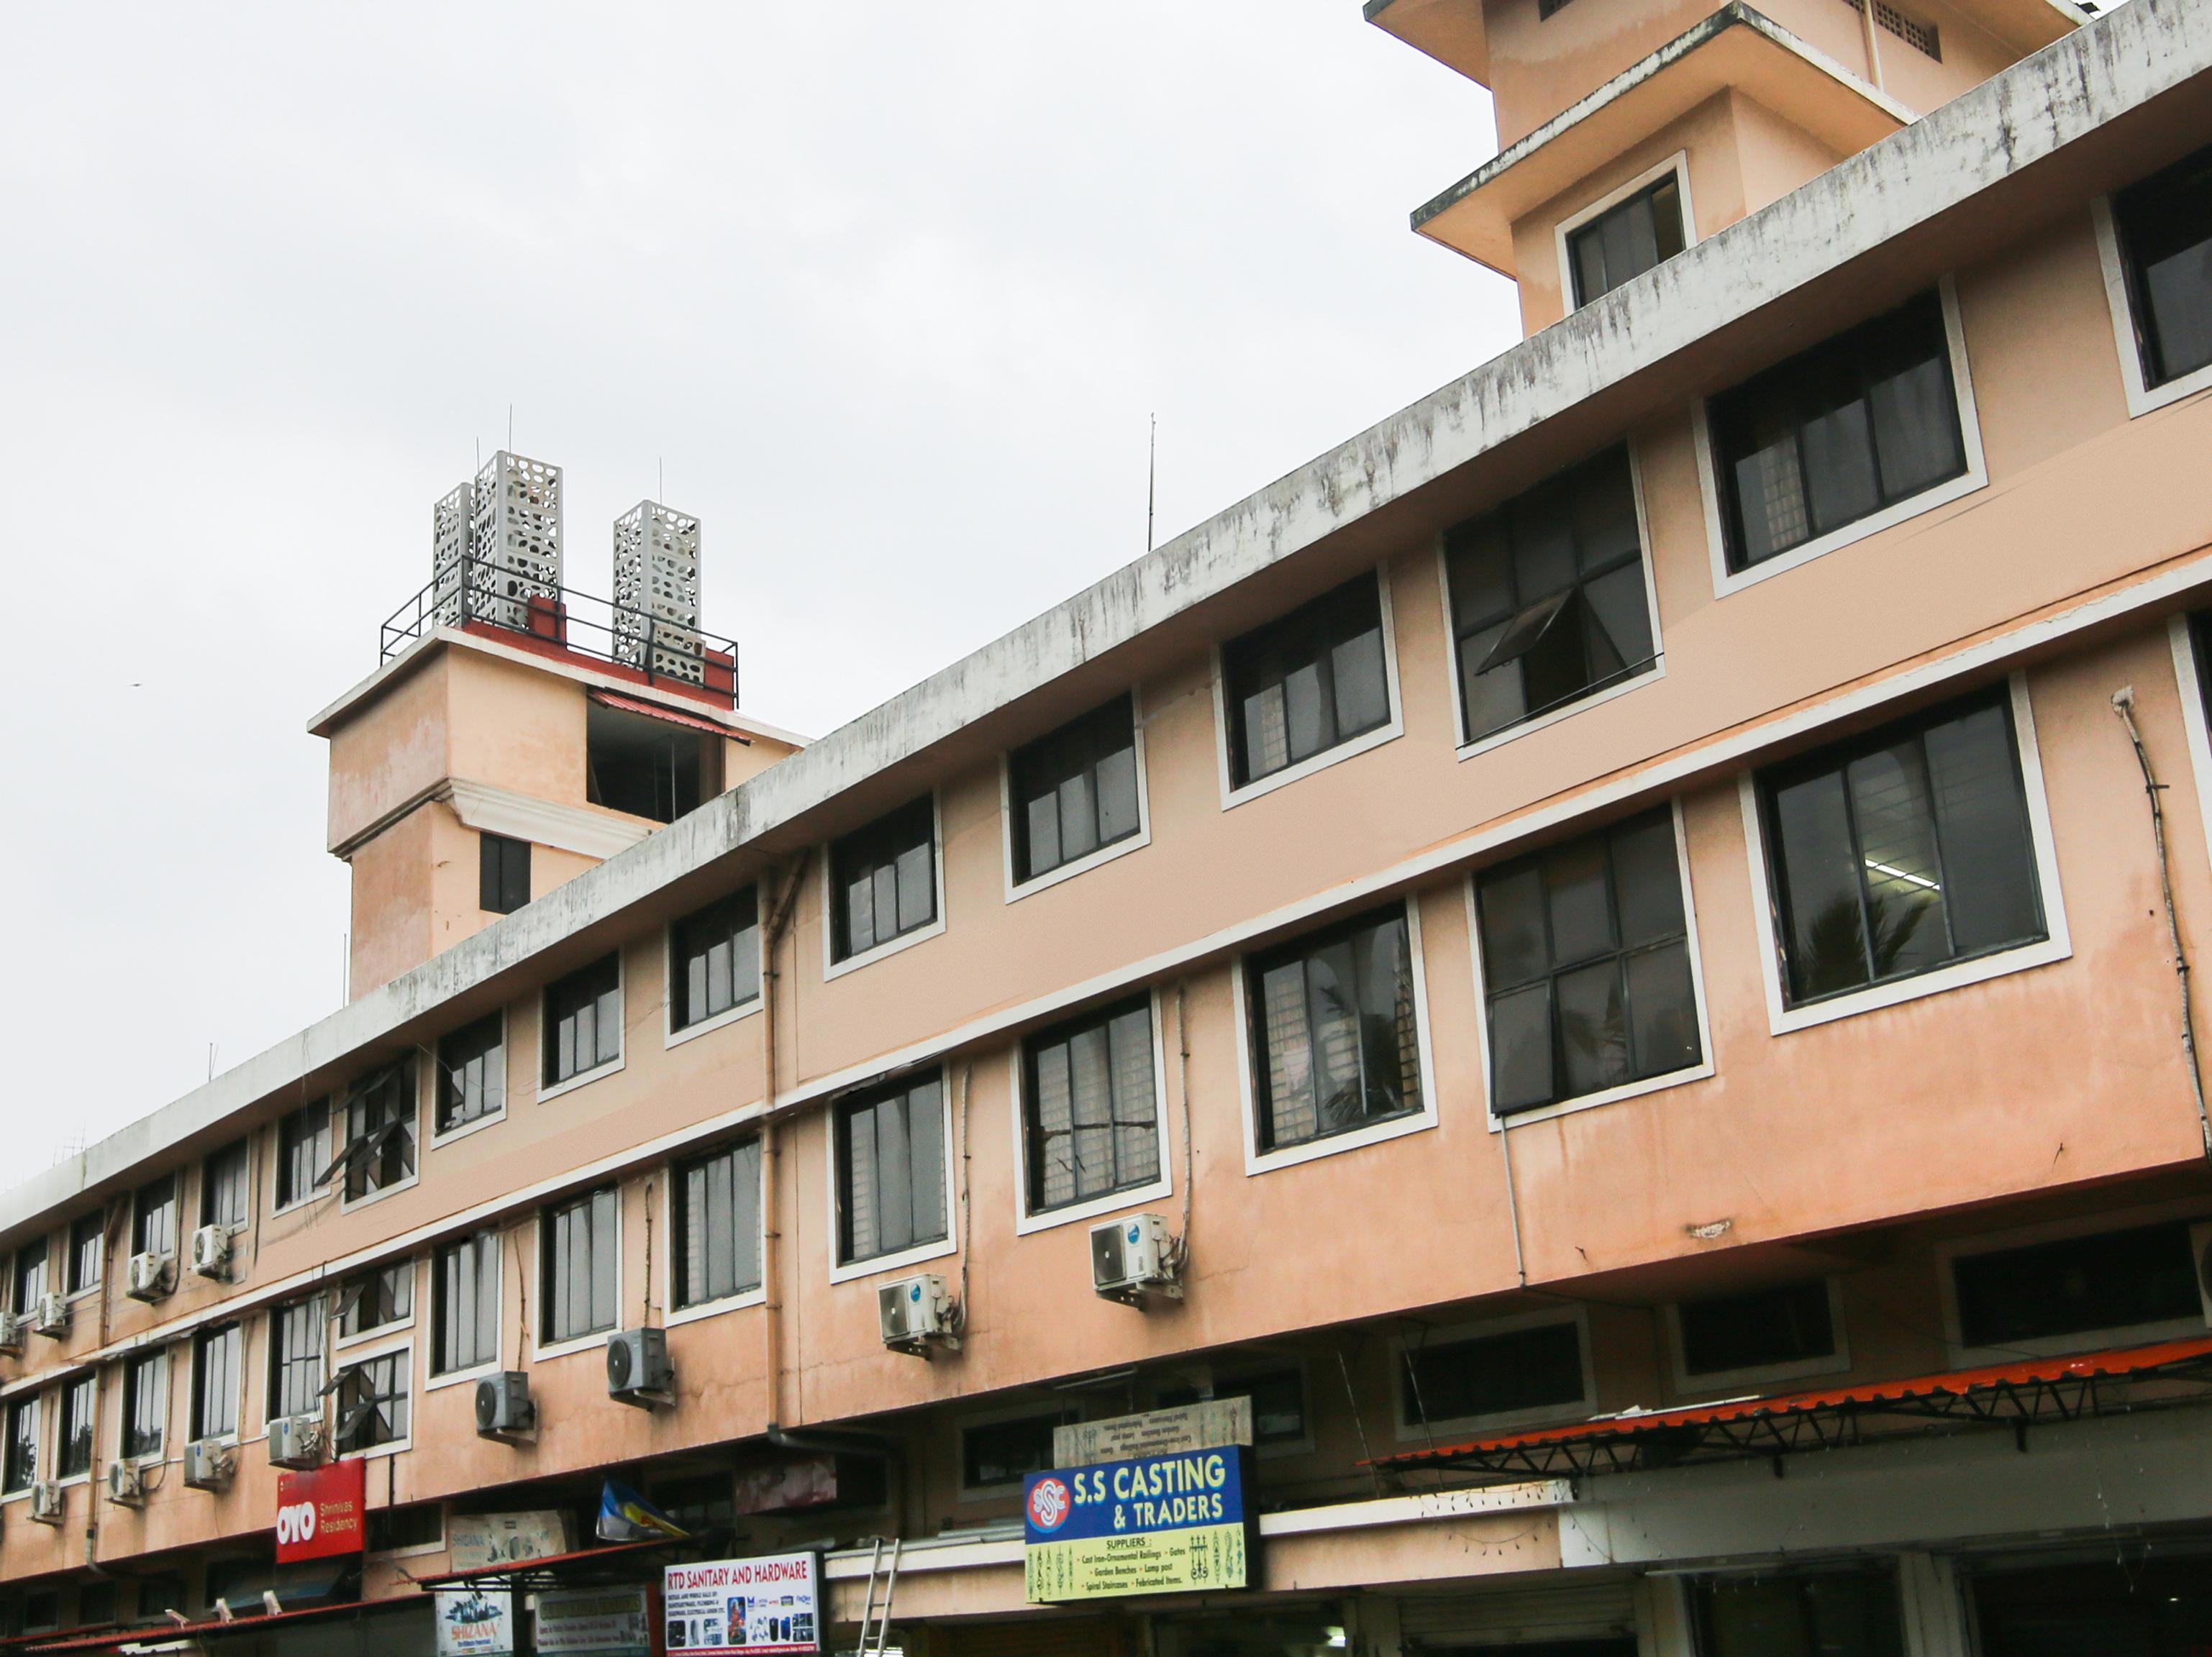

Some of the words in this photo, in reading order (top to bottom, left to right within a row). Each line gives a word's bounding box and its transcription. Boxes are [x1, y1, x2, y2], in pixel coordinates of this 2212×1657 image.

[1074, 1470, 1106, 1504] S.S
[1114, 1455, 1225, 1499] CASTING
[1114, 1505, 1126, 1529] &
[1134, 1494, 1222, 1526] TRADERS
[277, 1502, 316, 1545] OYO
[320, 1518, 358, 1533] Residency
[1106, 1538, 1146, 1549] SUPPLIERS
[1082, 1555, 1093, 1564] Cast
[1139, 1550, 1162, 1560] Railings
[1169, 1547, 1186, 1556] Gates
[668, 1572, 684, 1590] RTD
[688, 1568, 730, 1589] SANITARY
[732, 1566, 752, 1585] AND
[755, 1560, 807, 1583] HARDWARE
[1094, 1567, 1114, 1576] Garden
[1115, 1566, 1137, 1575] Benches
[1144, 1564, 1160, 1574] Lamp
[1161, 1563, 1173, 1572] post
[1085, 1581, 1101, 1592] Spiral
[1102, 1580, 1128, 1590] Staircases
[1136, 1577, 1164, 1587] Fabricated
